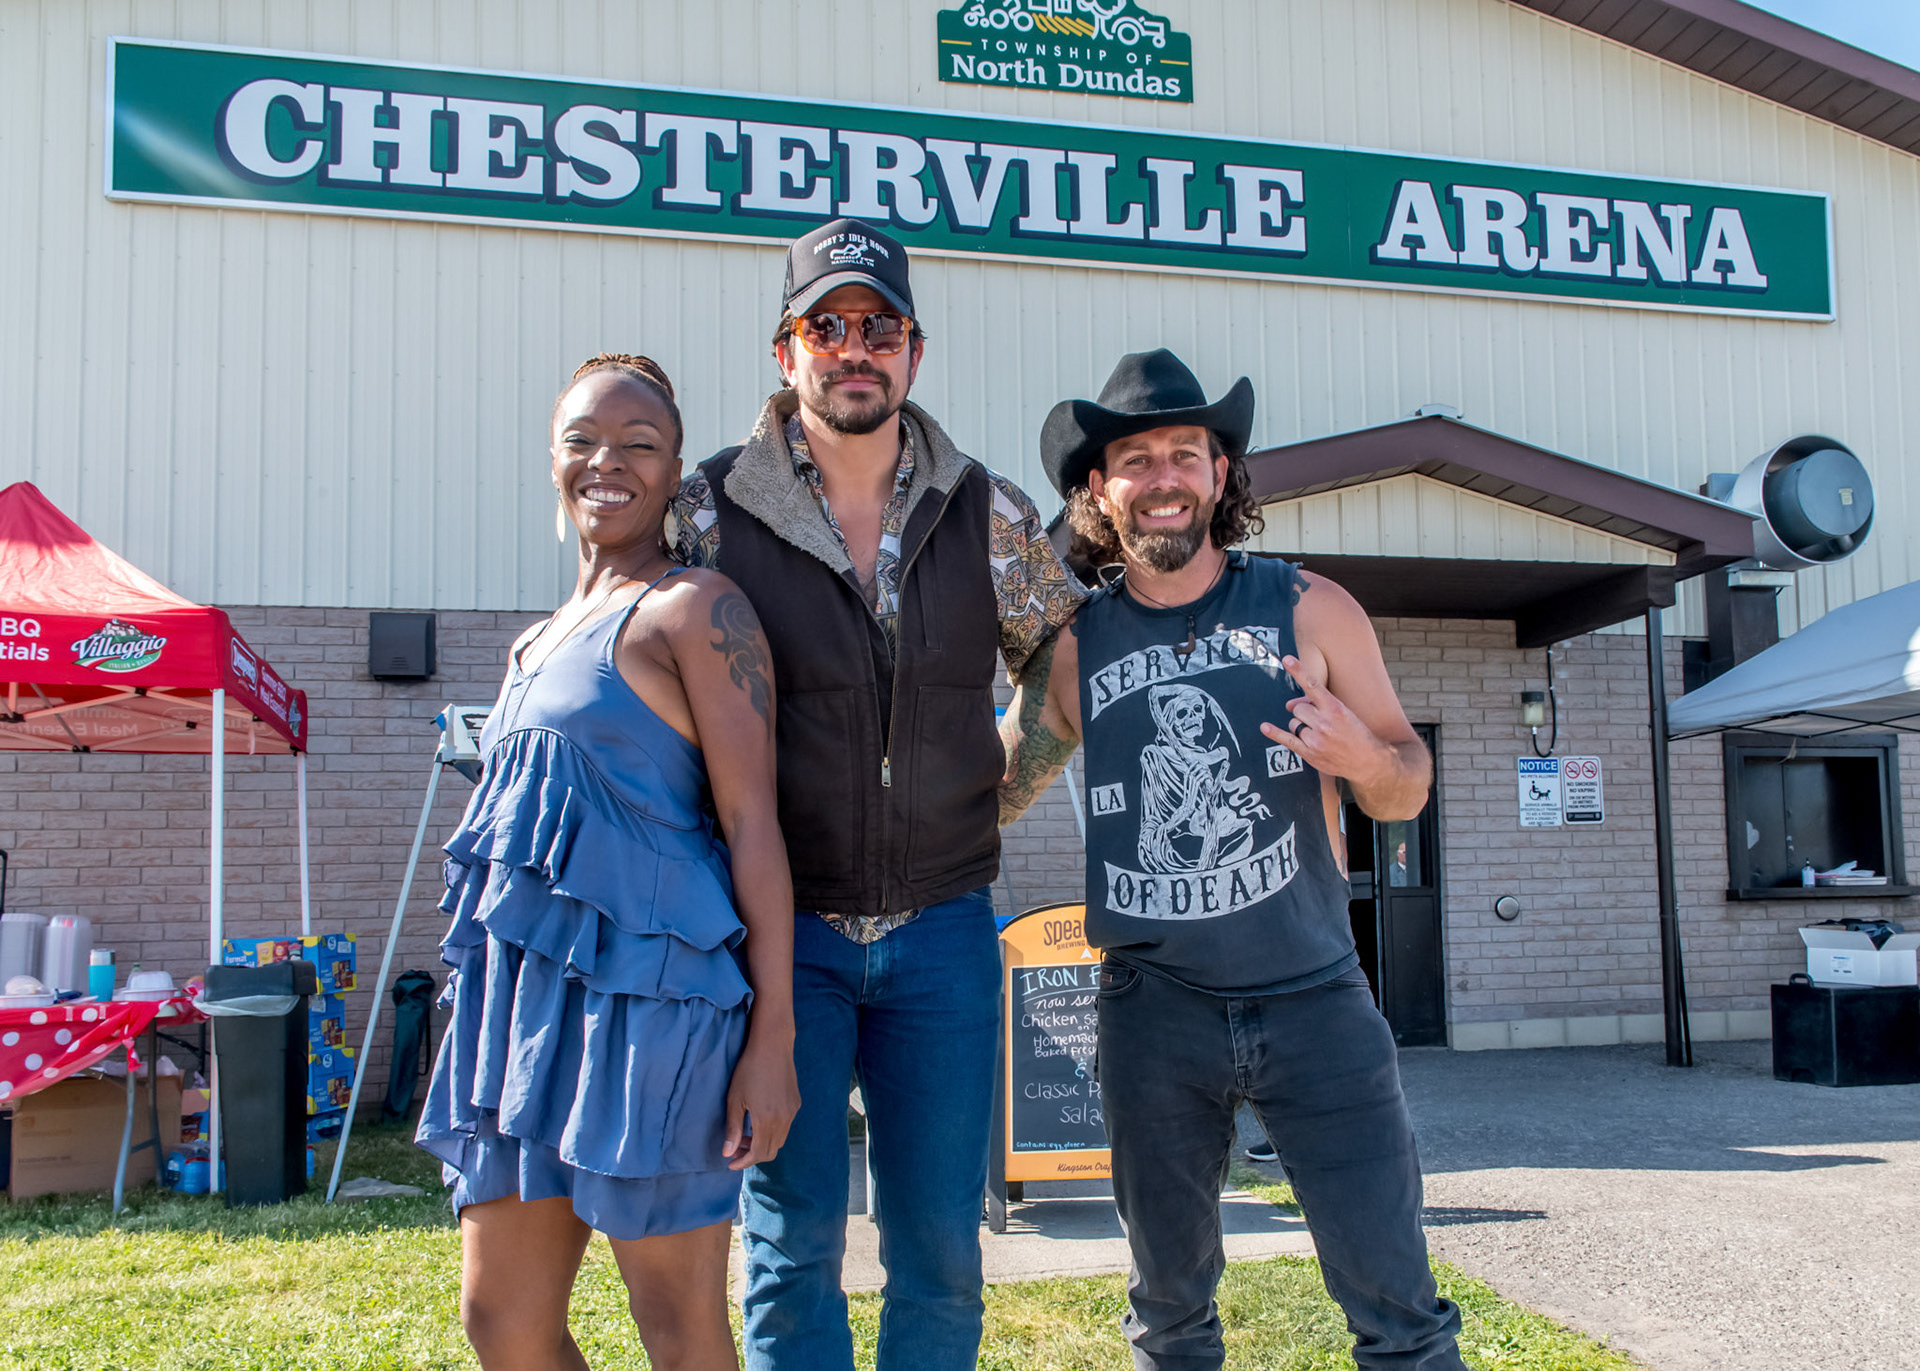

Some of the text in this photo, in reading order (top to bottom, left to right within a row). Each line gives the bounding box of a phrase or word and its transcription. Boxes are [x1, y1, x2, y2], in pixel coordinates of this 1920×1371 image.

[981, 38, 1153, 66] TOWNSHIP OF
[951, 53, 1182, 97] North Dundas
[218, 76, 1769, 292] CHESTERVILLE ARENA
[813, 232, 890, 260] BOBBY'S IDLE HOUR
[69, 633, 168, 661] Villaggio
[1270, 749, 1301, 773] CA
[1520, 761, 1557, 771] NOTICE
[1095, 788, 1122, 811] LA
[1113, 839, 1297, 916] OF DEATH
[1043, 919, 1086, 947] Spea
[1056, 940, 1086, 951] BREWING
[1020, 966, 1079, 997] IRON
[1021, 1011, 1078, 1028] Chicken
[1034, 1046, 1067, 1058] Baked
[1024, 1082, 1080, 1099] Classic
